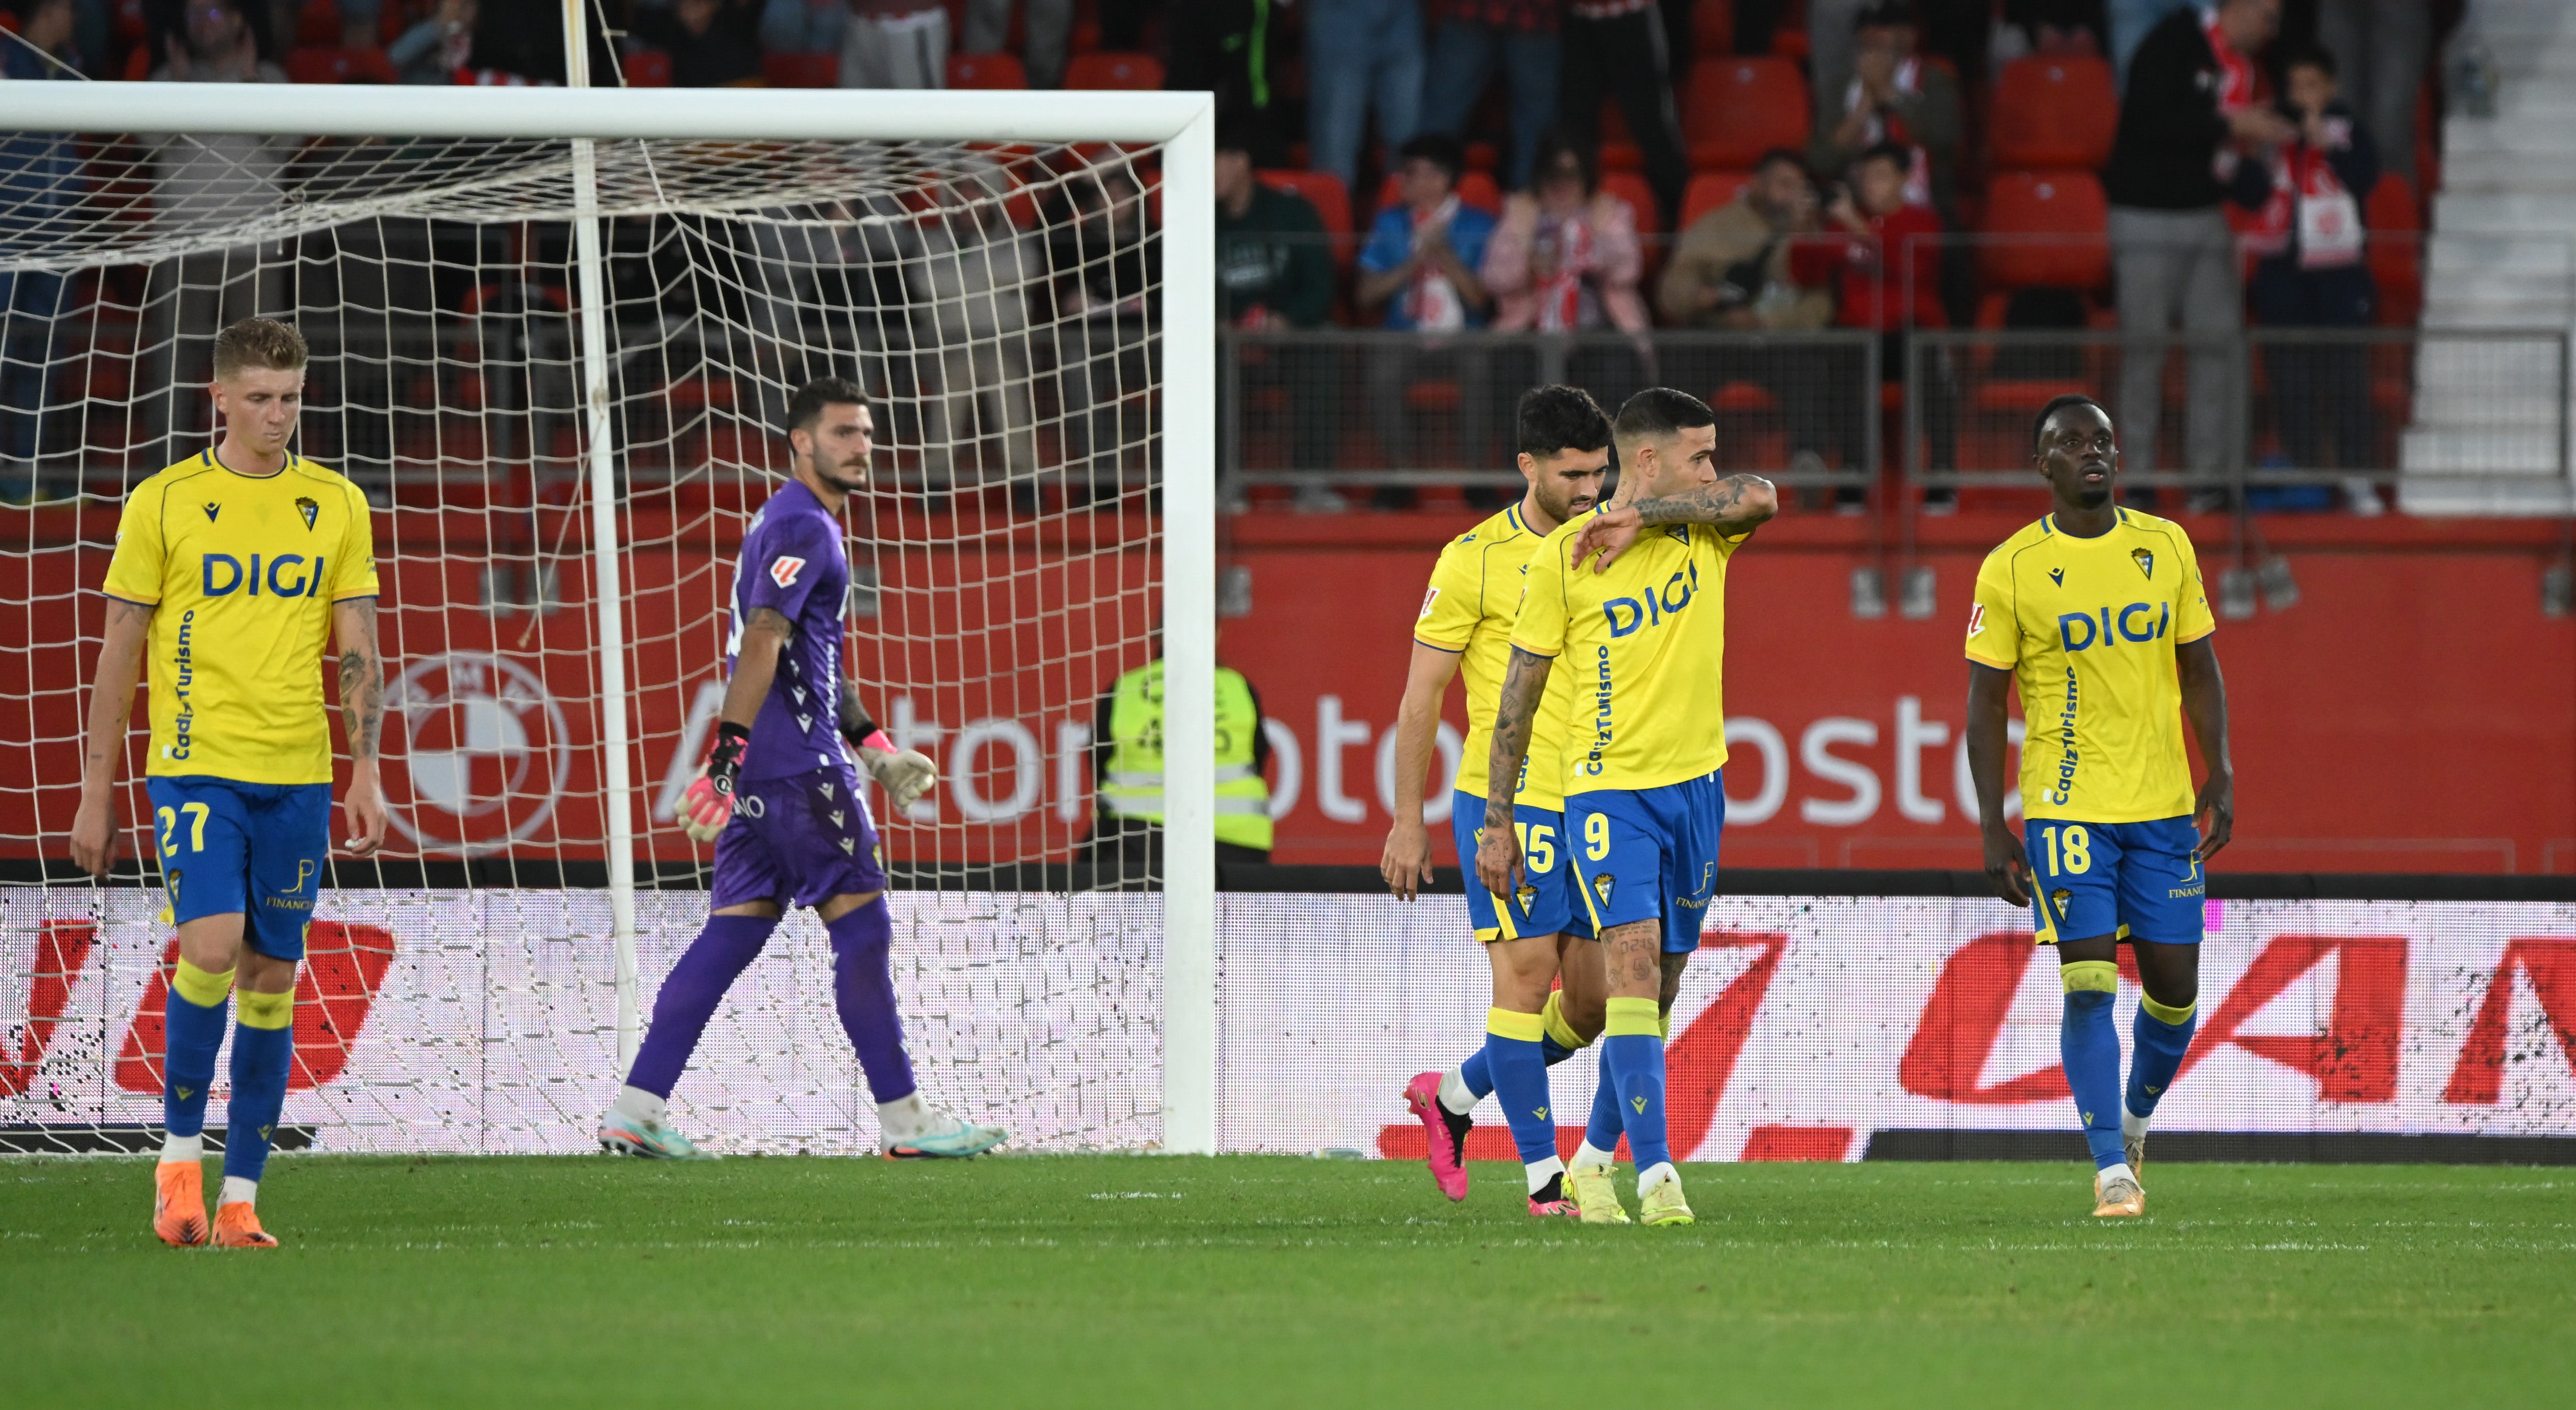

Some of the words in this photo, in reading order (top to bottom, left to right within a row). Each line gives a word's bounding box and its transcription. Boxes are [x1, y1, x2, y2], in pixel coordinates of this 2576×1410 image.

[203, 553, 324, 598] DIGI
[1603, 558, 1698, 638] DIGI
[2058, 601, 2169, 653] DIGI
[158, 802, 209, 858] 27
[1585, 812, 1610, 861] 9
[2042, 825, 2090, 876] 18
